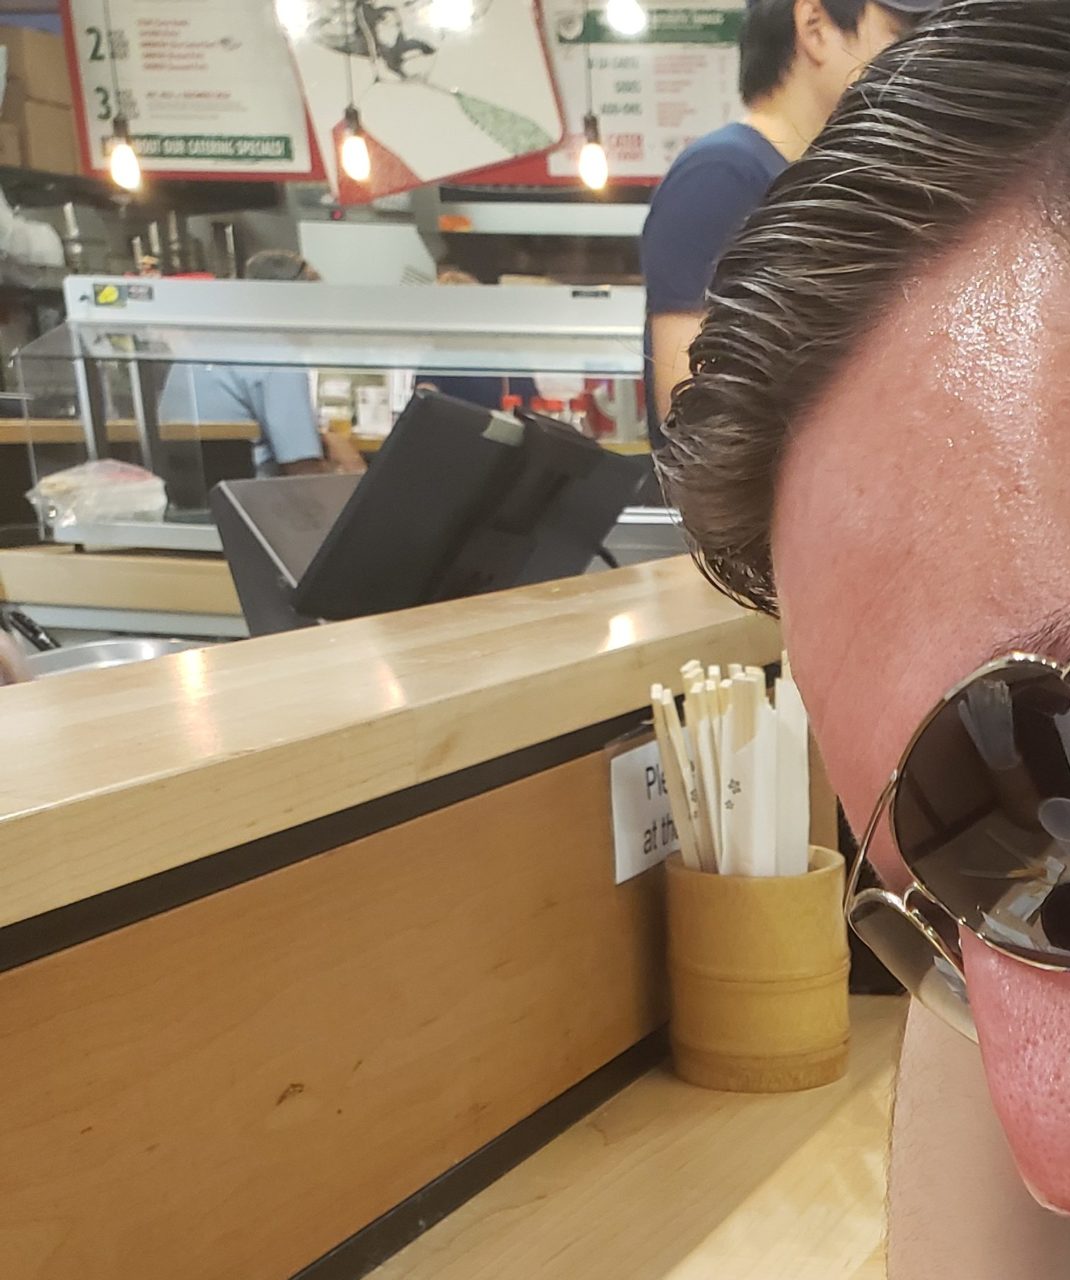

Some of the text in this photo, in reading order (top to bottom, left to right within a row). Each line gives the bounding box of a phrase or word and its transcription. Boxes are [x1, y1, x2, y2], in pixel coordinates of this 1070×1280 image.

[86, 27, 105, 61] 2
[94, 86, 111, 120] 3
[643, 821, 658, 854] at
